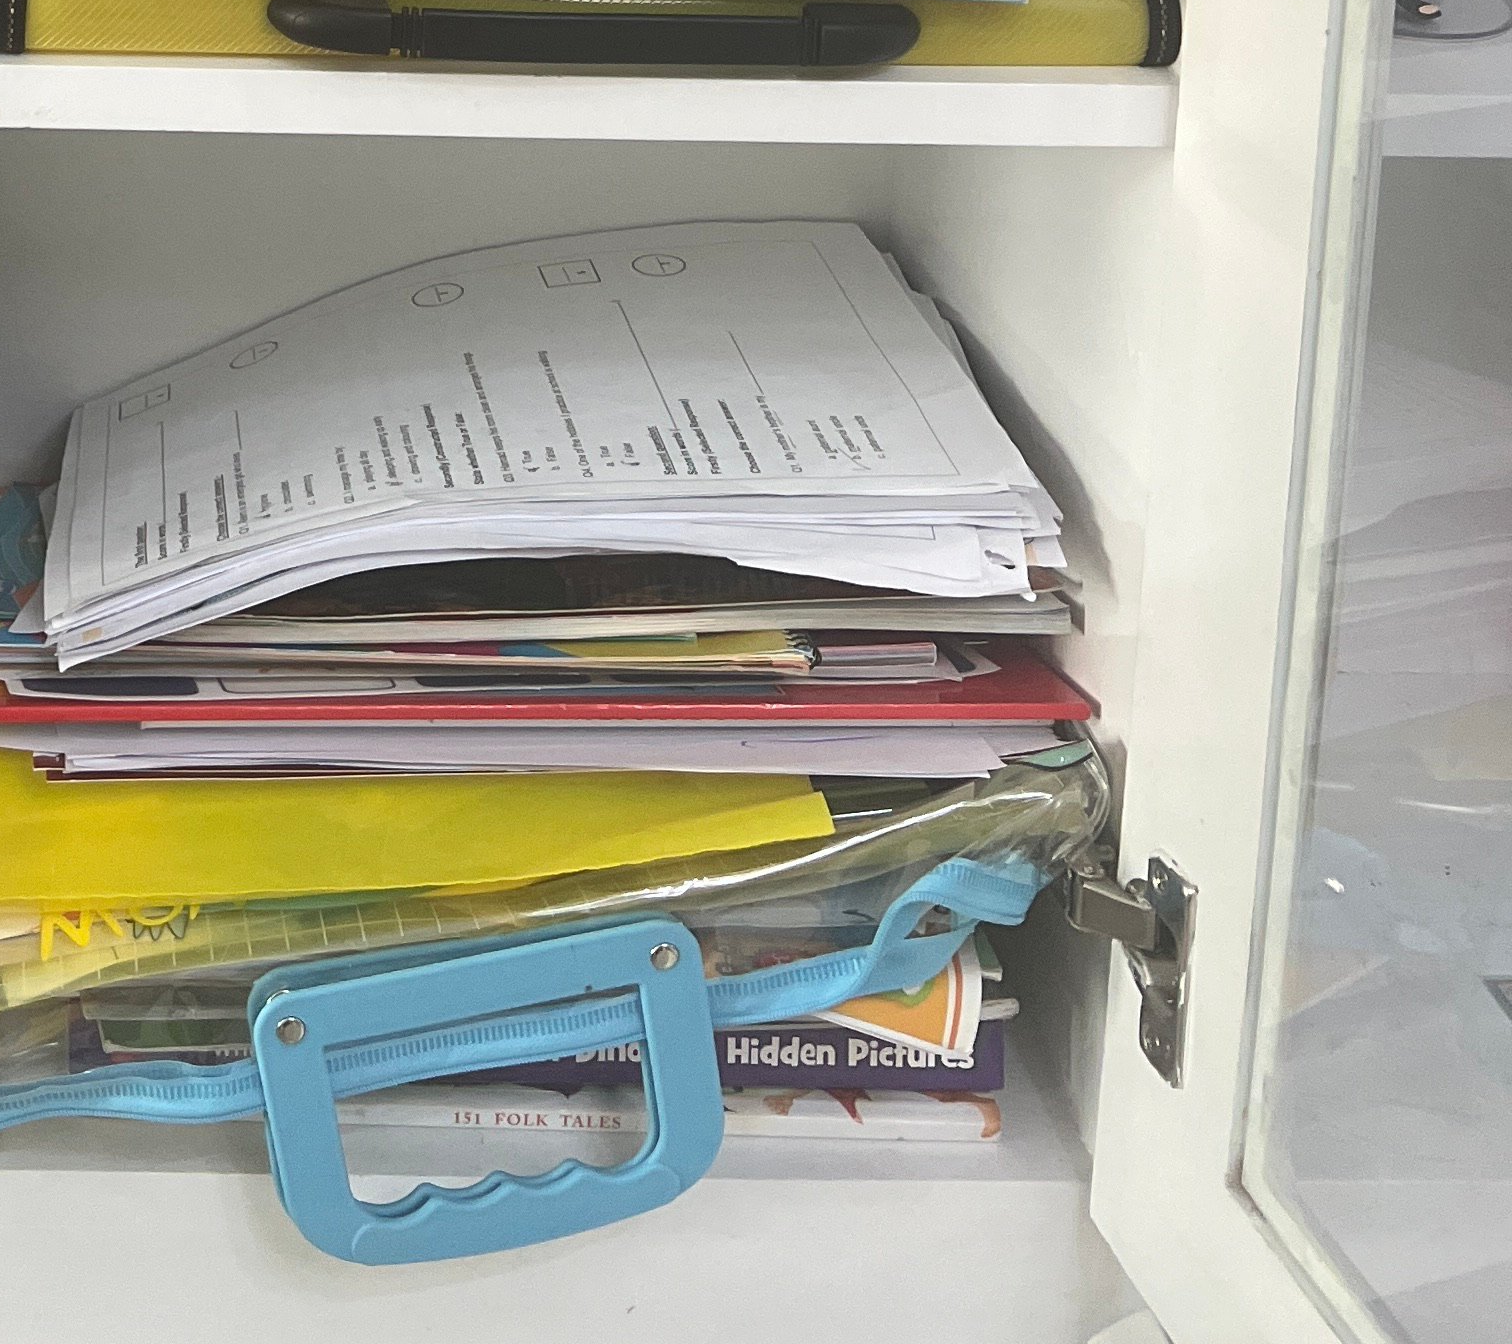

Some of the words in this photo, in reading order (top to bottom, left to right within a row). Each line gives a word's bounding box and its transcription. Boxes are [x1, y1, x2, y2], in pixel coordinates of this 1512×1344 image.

[596, 443, 612, 460] True
[620, 440, 636, 459] False
[727, 1036, 836, 1067] Hidden
[453, 1111, 480, 1125] 151
[494, 1112, 547, 1127] FOLK
[558, 1113, 621, 1129] TALES
